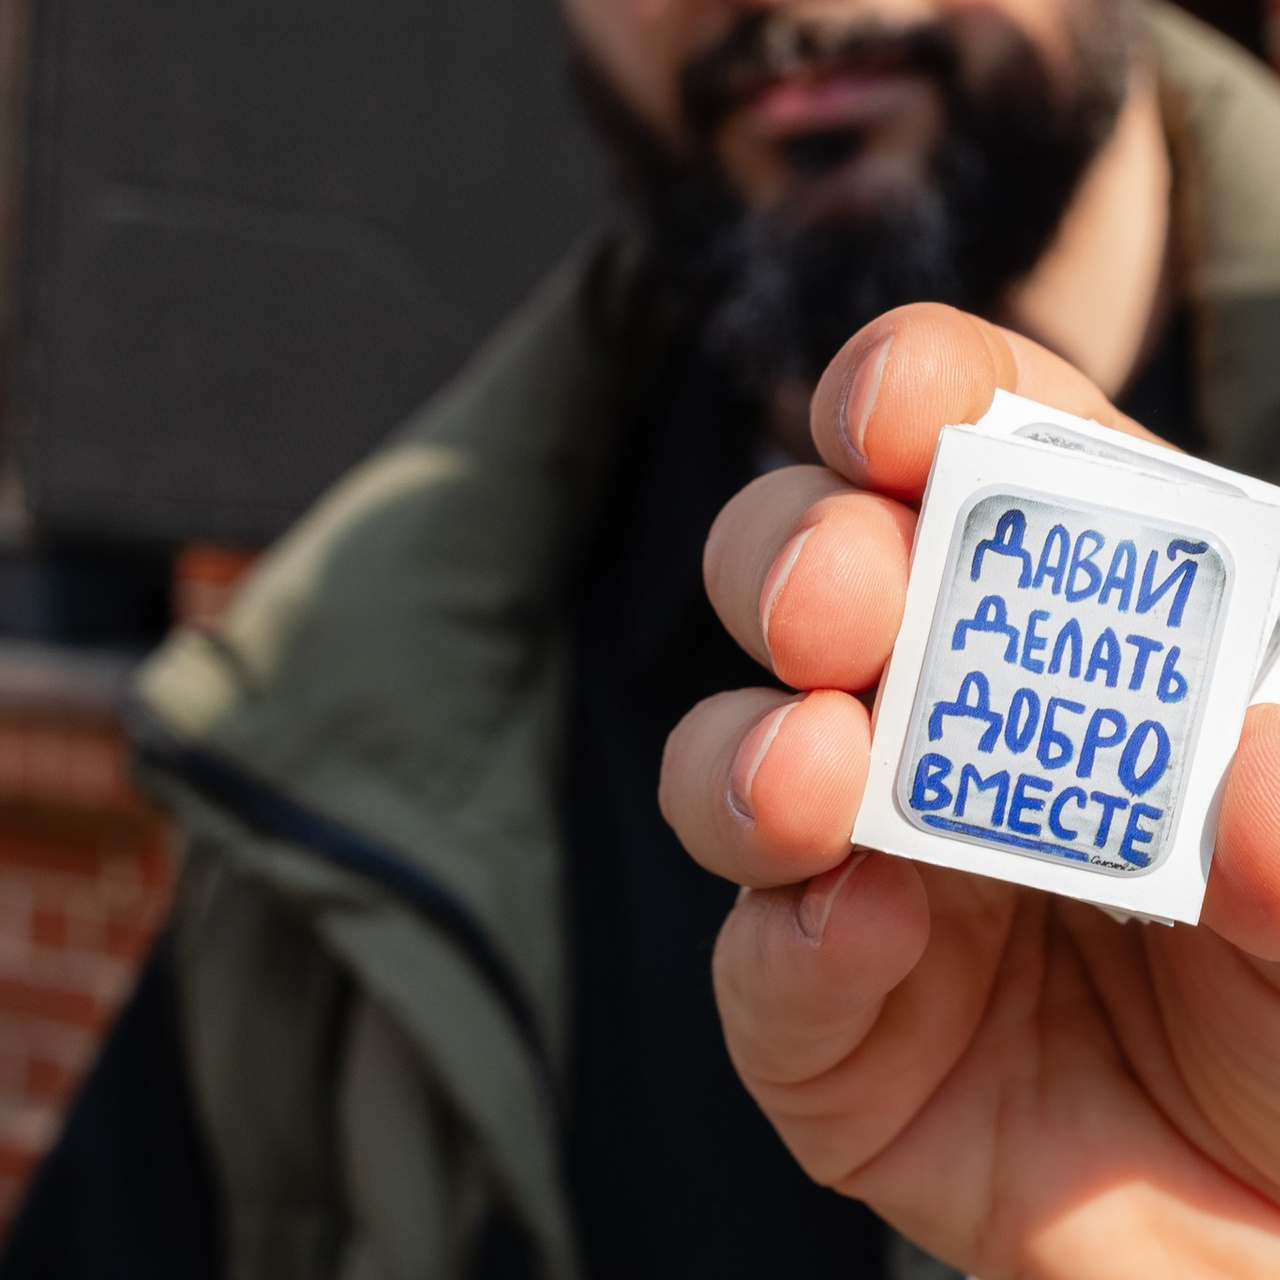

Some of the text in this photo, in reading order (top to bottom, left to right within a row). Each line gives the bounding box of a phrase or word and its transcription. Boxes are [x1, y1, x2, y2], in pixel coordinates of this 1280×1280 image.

[971, 509, 1208, 628] ДАВАЙ
[951, 595, 1189, 703] ДЕЛАТЬ
[928, 671, 1171, 797] ДОБРО
[909, 753, 1162, 869] ВМЕСТЕ
